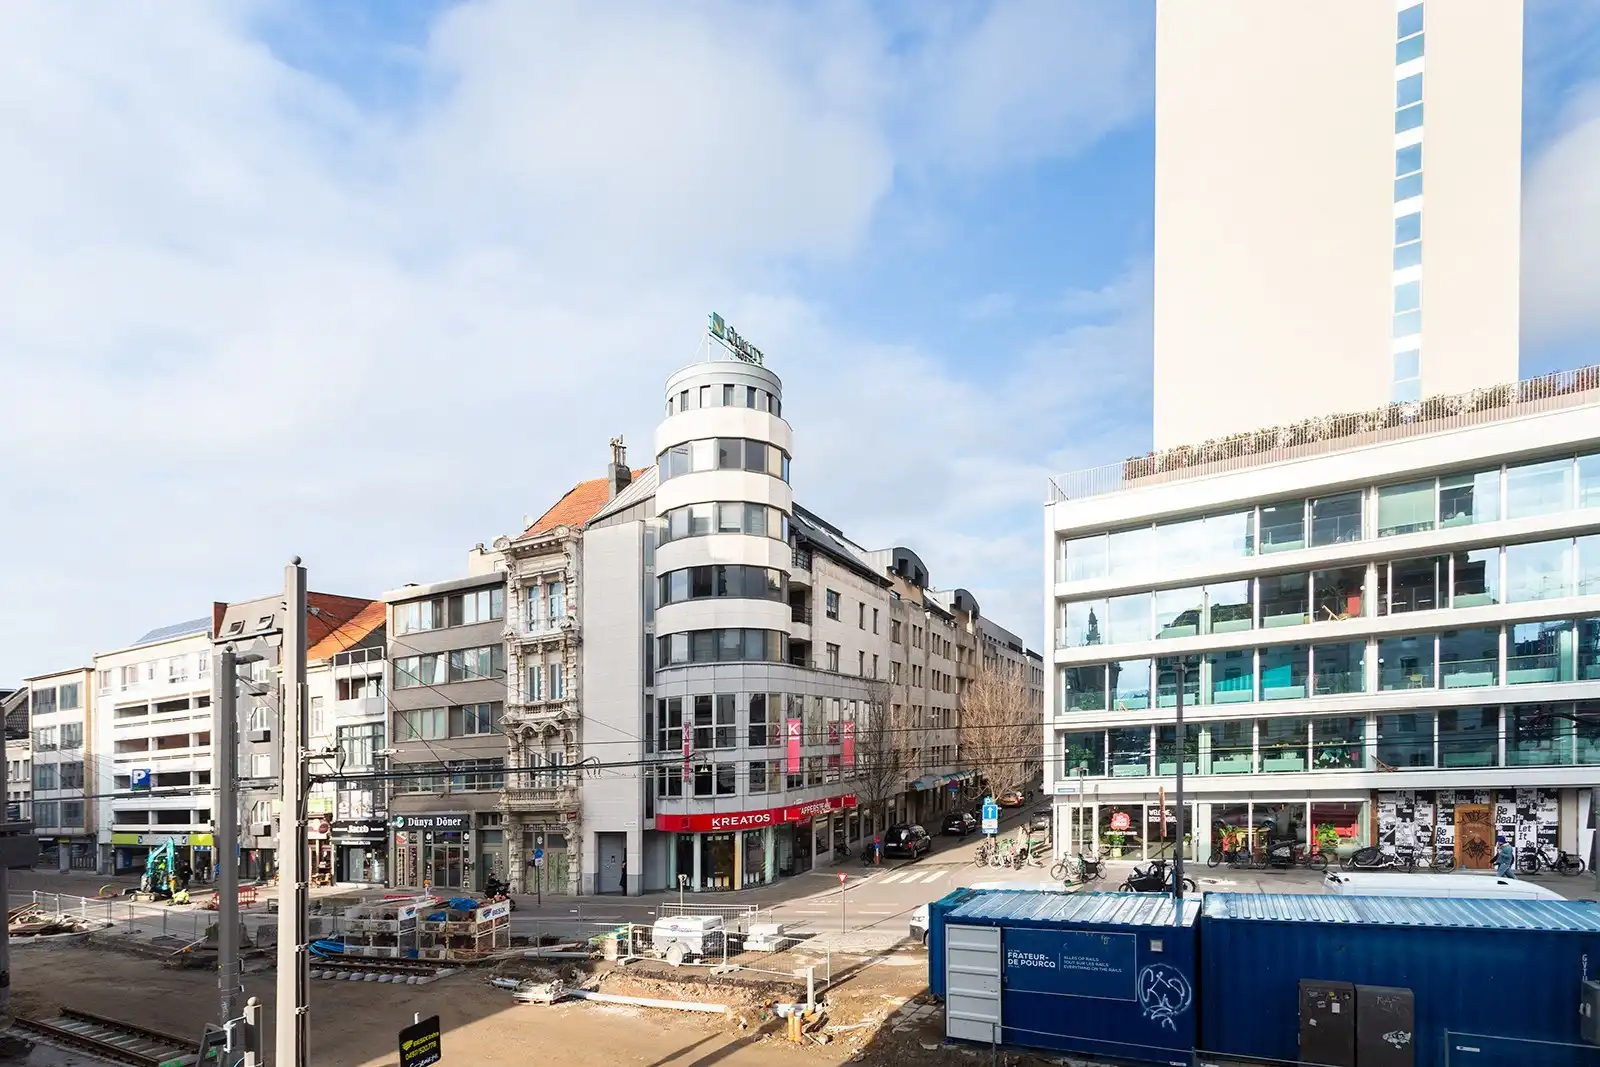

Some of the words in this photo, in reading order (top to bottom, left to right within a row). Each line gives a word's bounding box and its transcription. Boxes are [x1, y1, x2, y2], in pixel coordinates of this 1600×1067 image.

[788, 722, 800, 736] K
[843, 723, 854, 734] K
[133, 770, 146, 784] P
[1497, 806, 1508, 815] Be
[408, 817, 433, 828] Dünya
[436, 816, 462, 826] Döner
[712, 813, 770, 828] KREATOS
[1496, 814, 1517, 824] Real
[1007, 952, 1049, 961] FRATEUR-
[1020, 959, 1056, 968] POURCQ
